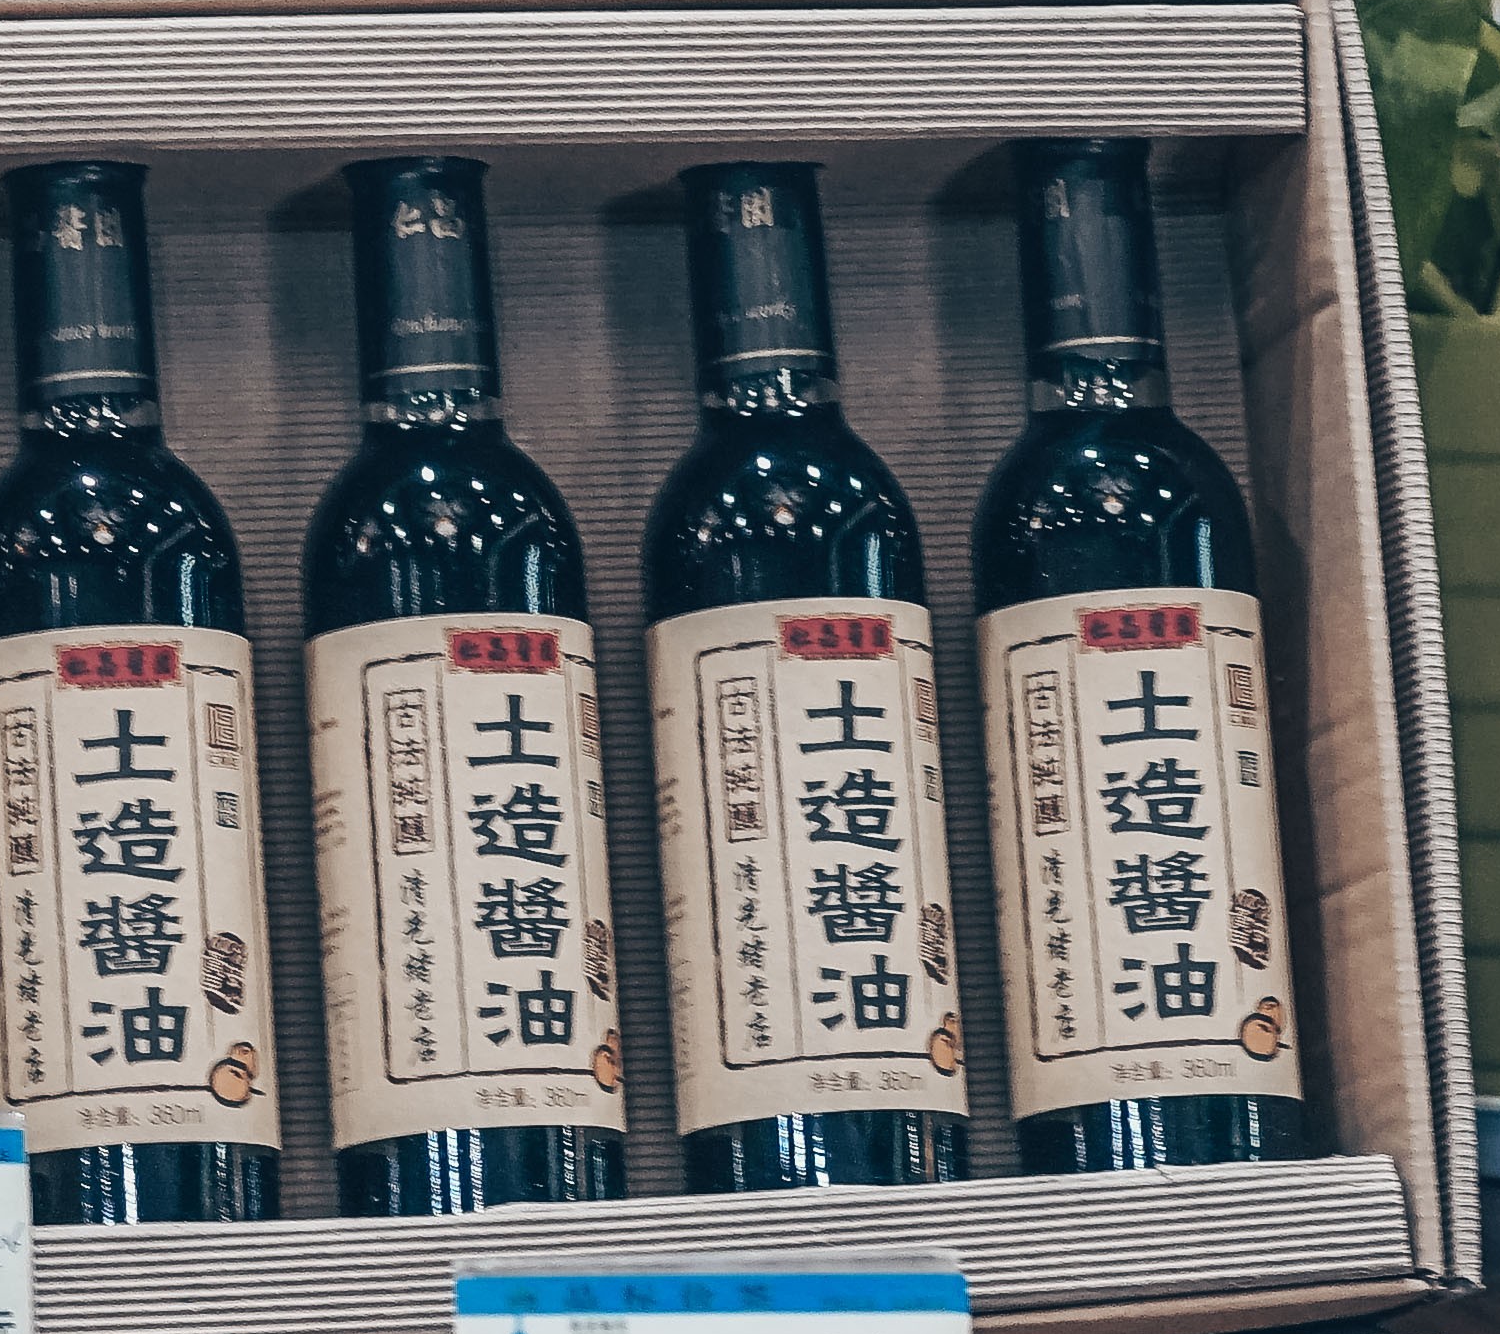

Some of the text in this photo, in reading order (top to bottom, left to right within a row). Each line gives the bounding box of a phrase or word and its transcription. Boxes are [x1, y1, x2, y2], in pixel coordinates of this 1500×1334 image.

[74, 708, 190, 1065] 土造醬油
[464, 694, 575, 1046] 土造醬油
[799, 680, 909, 1031] 土造醬油
[1100, 670, 1219, 1020] 土造醬油
